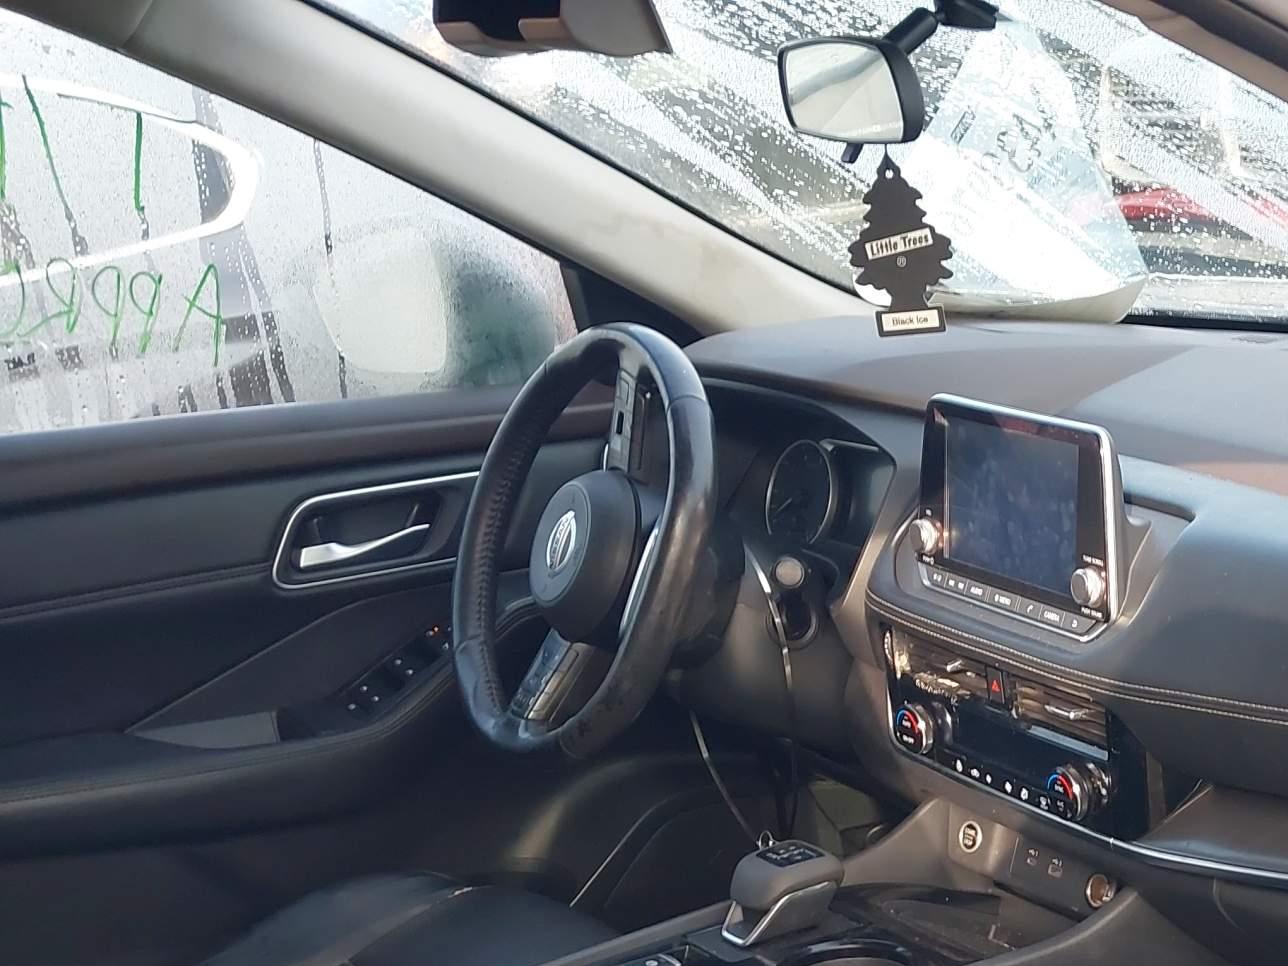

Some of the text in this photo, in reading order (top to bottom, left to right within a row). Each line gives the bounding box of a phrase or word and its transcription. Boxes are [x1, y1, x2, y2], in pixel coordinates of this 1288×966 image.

[870, 233, 929, 256] Little Trees
[891, 315, 929, 326] Black Ice
